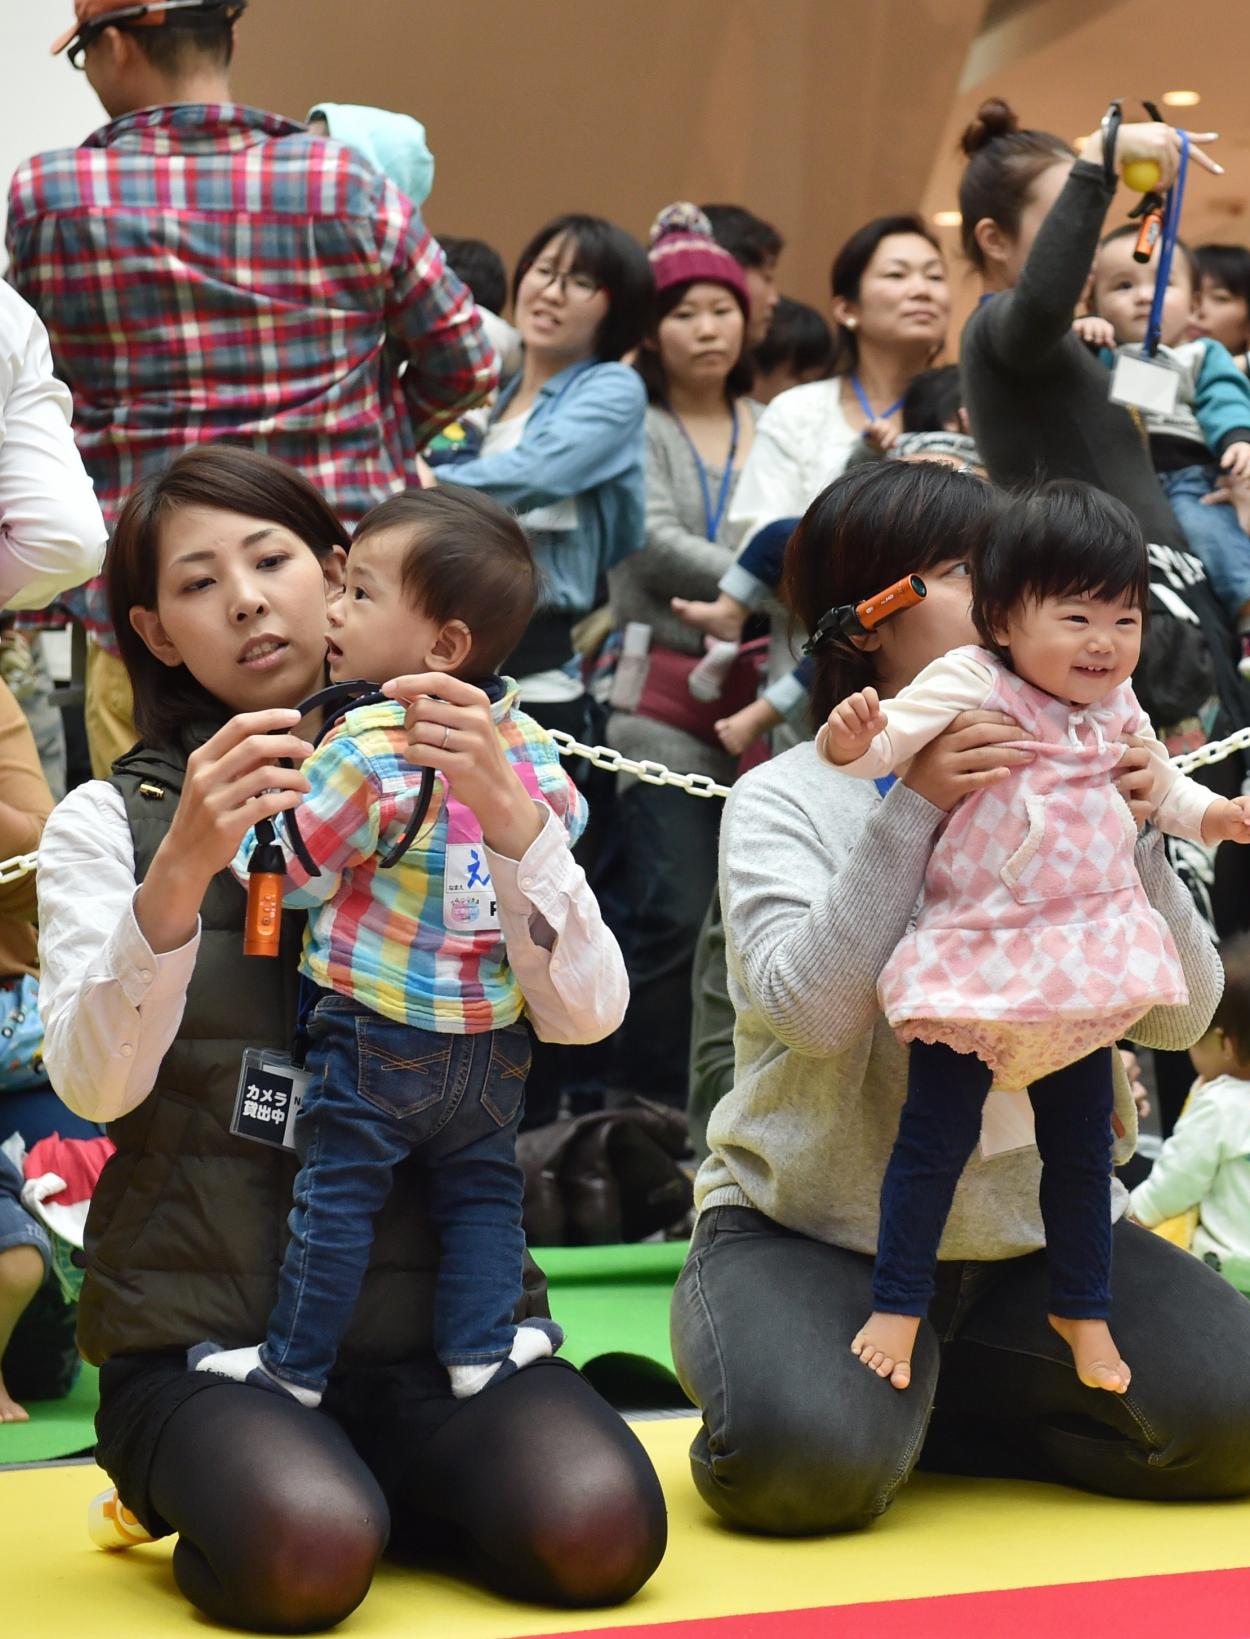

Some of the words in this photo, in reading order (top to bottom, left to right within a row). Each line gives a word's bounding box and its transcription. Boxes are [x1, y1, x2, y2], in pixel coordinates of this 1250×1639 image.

[246, 1084, 288, 1107] カメラ
[242, 1100, 286, 1125] 貸出中
